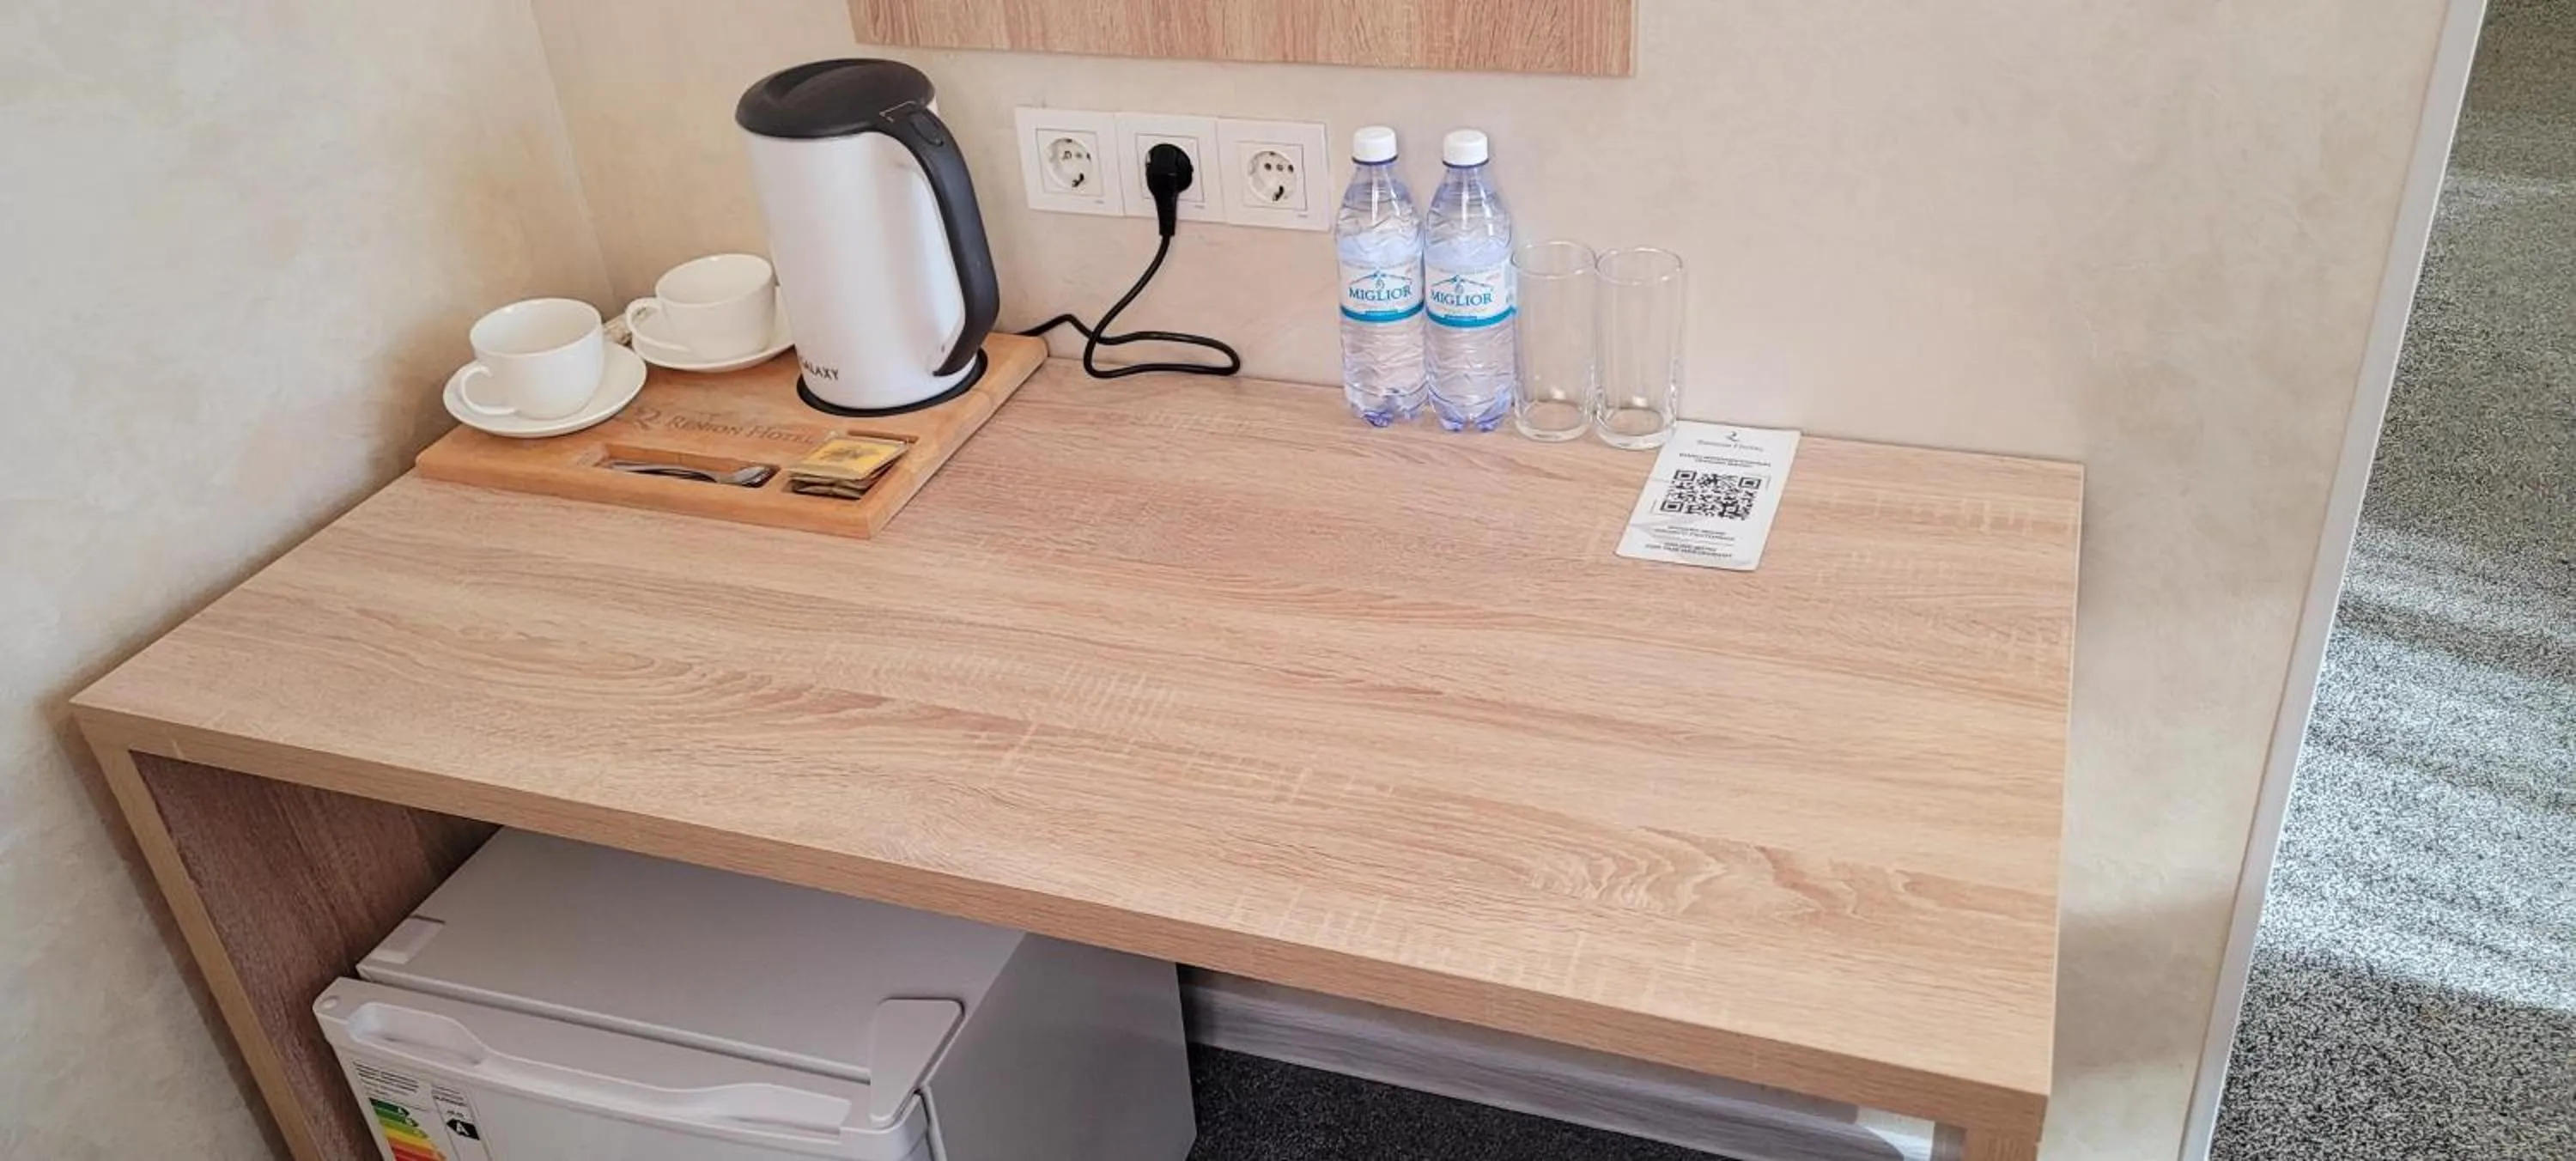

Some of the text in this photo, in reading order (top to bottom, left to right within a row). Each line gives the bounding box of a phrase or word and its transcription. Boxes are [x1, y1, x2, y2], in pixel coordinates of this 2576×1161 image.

[1348, 285, 1412, 301] MIGLIOR
[1431, 290, 1493, 306] MIGLIOR
[456, 1121, 471, 1136] A
